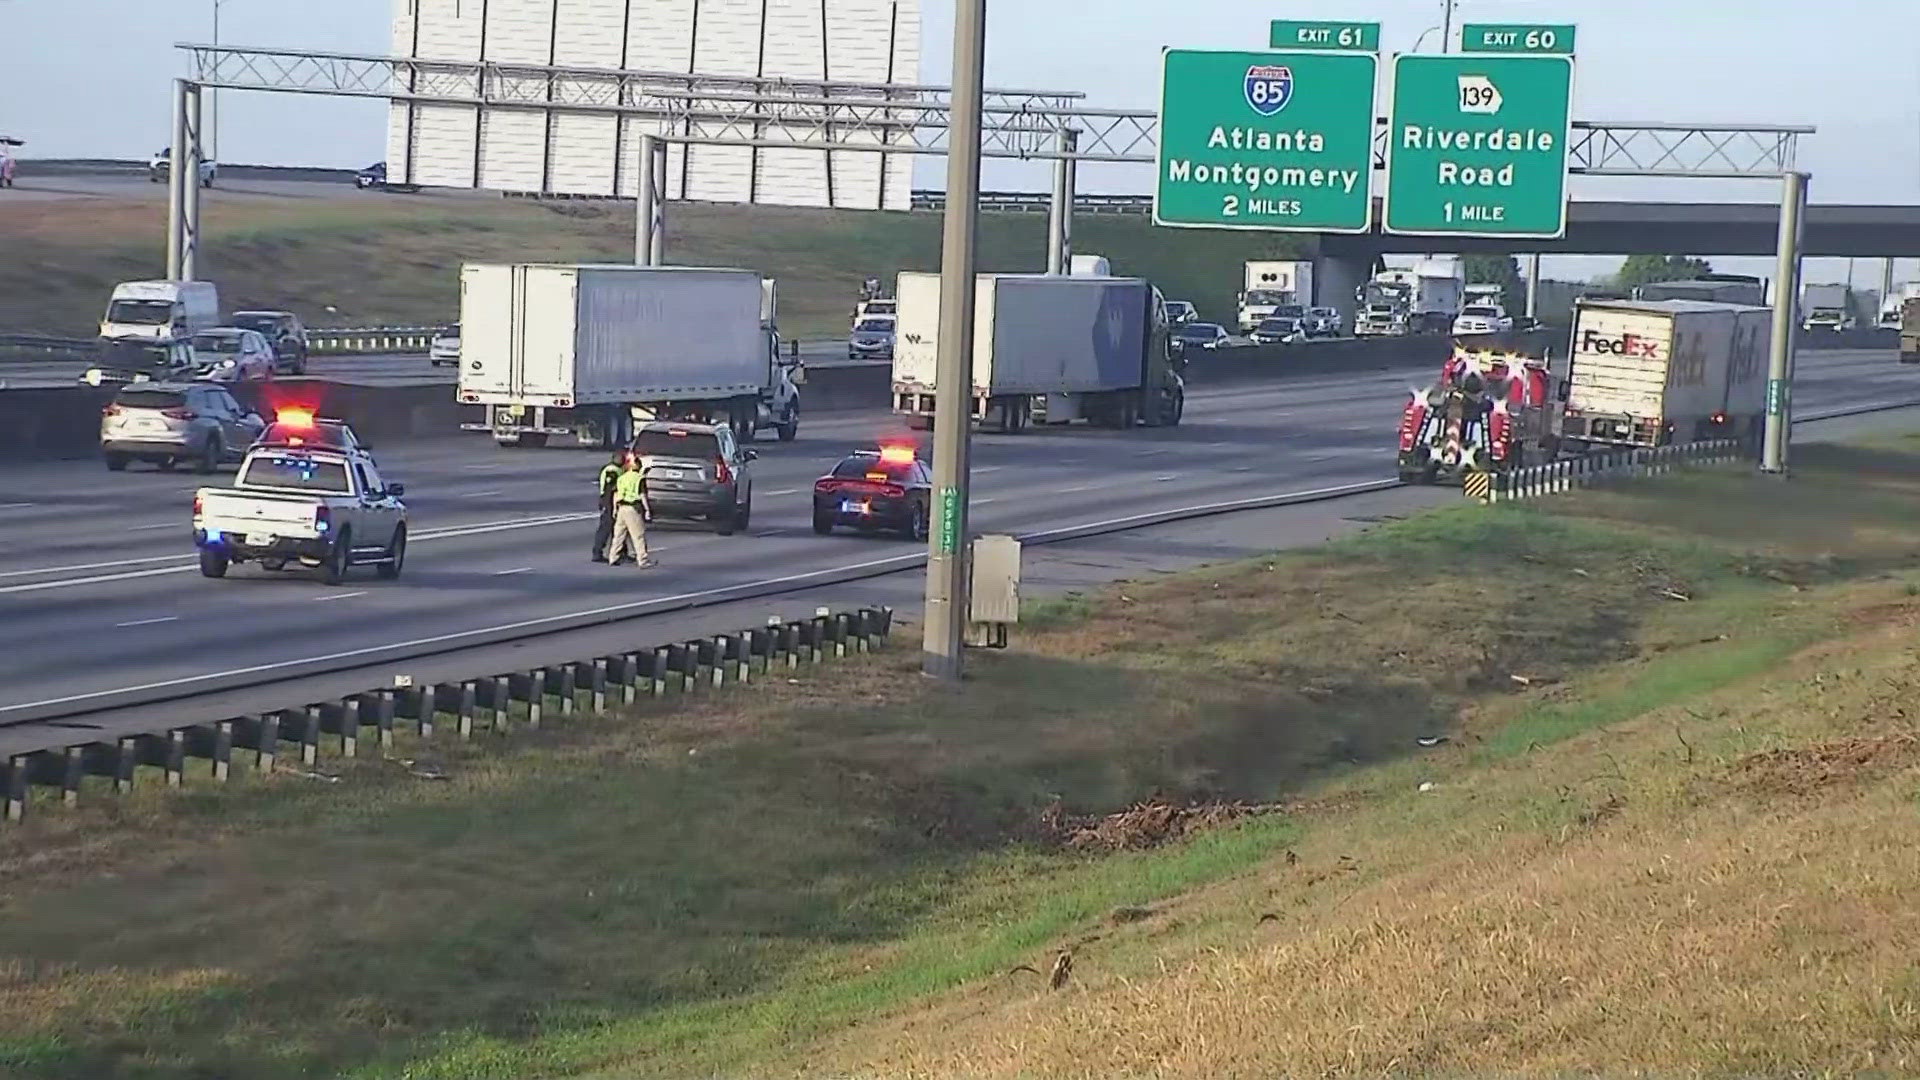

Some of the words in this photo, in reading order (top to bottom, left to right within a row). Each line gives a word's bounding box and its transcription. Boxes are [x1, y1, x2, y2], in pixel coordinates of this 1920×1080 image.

[1298, 28, 1330, 42] EXIT
[1338, 27, 1362, 46] 61
[1483, 31, 1517, 45] EXIT
[1525, 30, 1555, 49] 60
[1252, 81, 1284, 104] 85
[1462, 87, 1493, 107] 139
[1208, 126, 1324, 152] Atlanta
[1403, 125, 1554, 151] Riverdale
[1169, 159, 1358, 194] Montgomery
[1438, 161, 1514, 186] Road
[1222, 195, 1239, 216] 2
[1248, 199, 1301, 215] MILES
[1443, 201, 1453, 223] 1
[1461, 205, 1505, 221] MILE
[1583, 329, 1659, 358] FedEx
